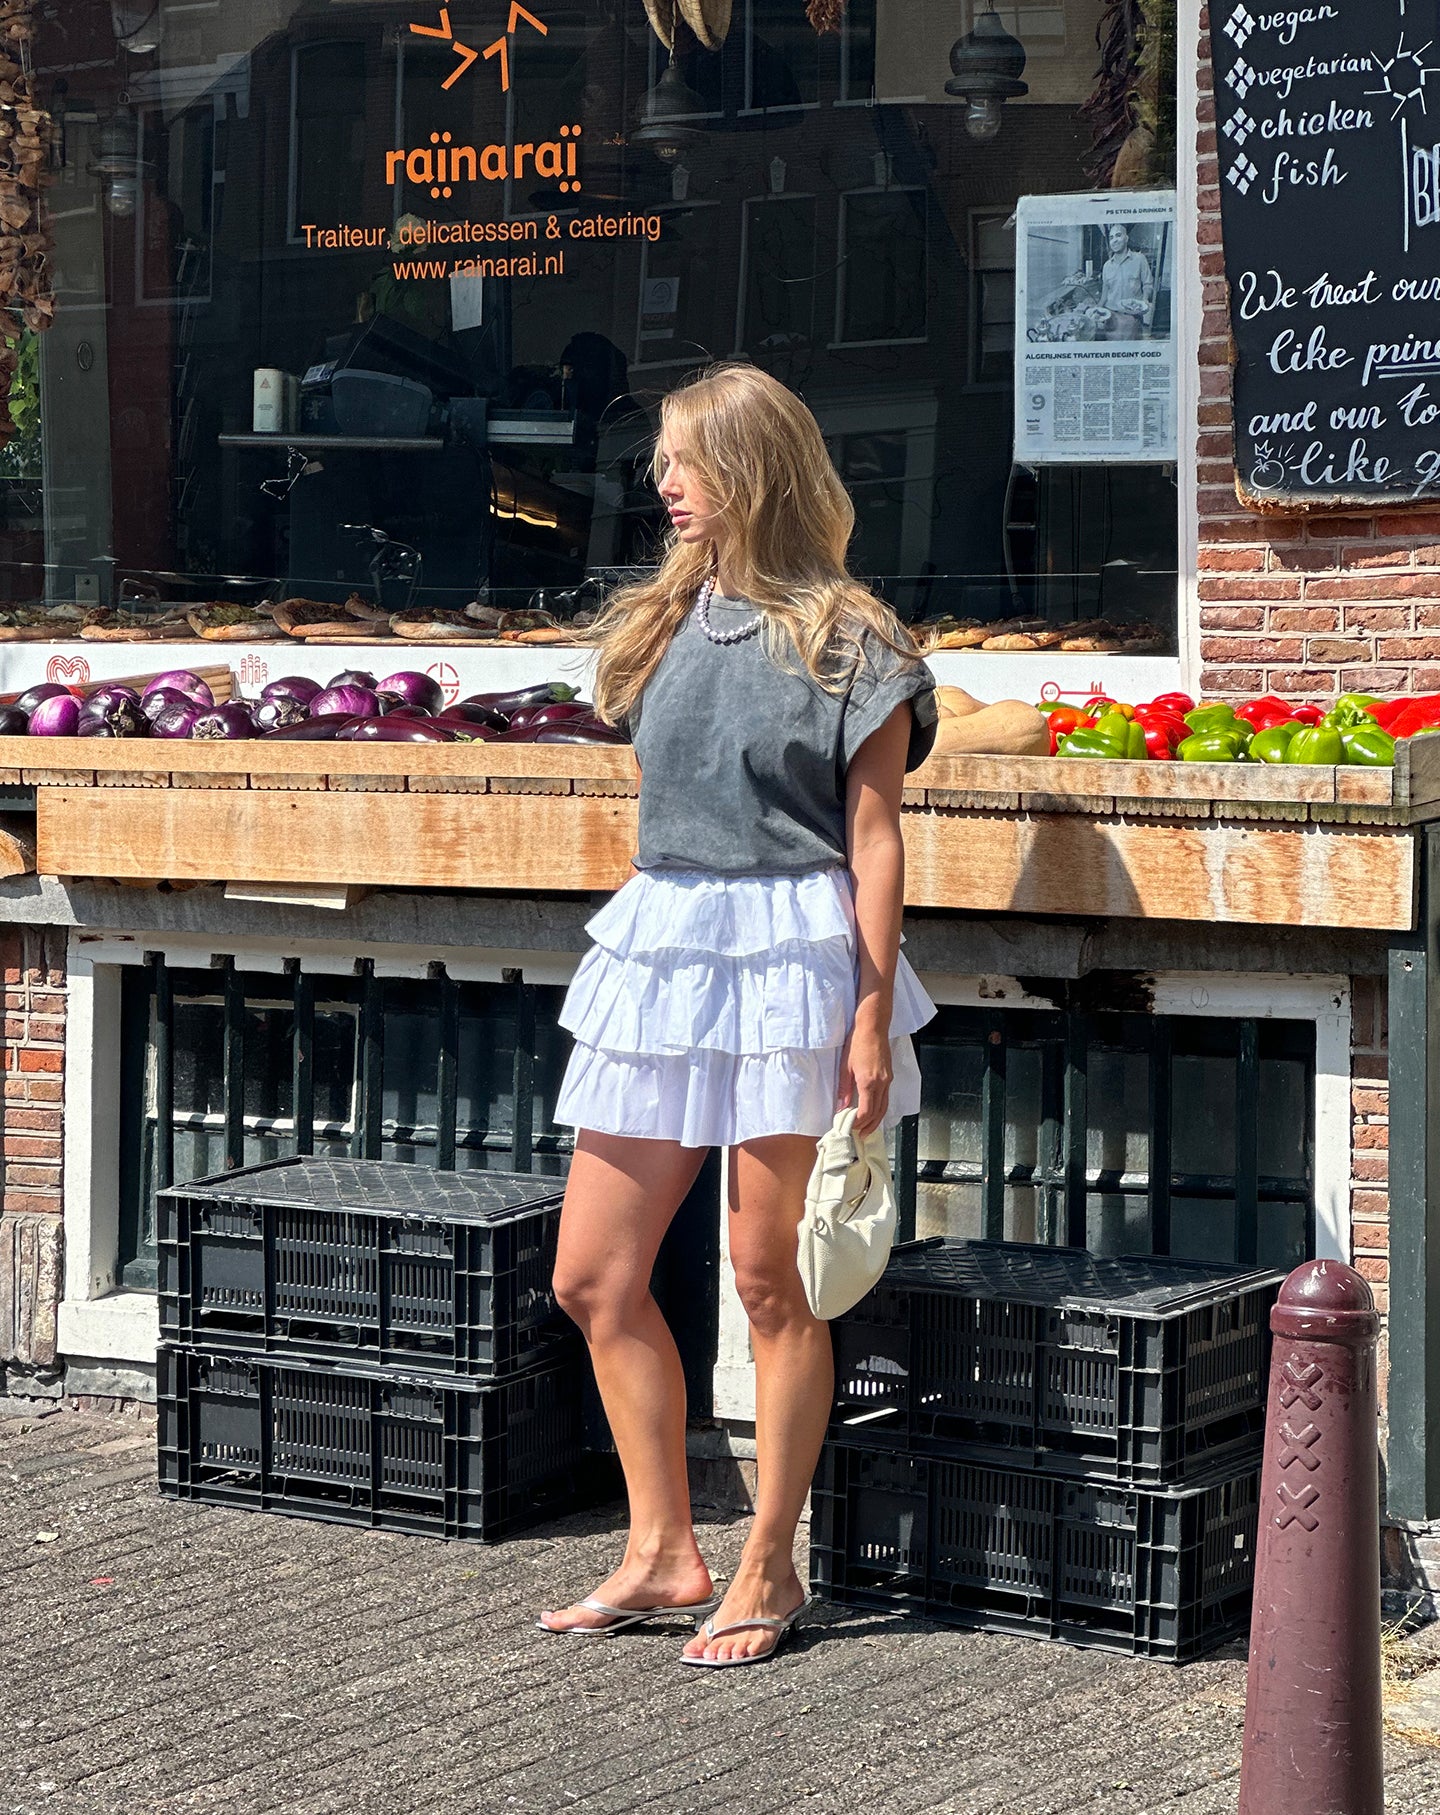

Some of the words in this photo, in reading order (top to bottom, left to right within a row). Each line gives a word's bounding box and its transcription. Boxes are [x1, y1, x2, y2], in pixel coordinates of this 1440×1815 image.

[1258, 4, 1339, 45] vegan
[1257, 52, 1373, 99] vegetarian
[1260, 100, 1375, 139] chicken
[1262, 148, 1349, 204] fish
[301, 223, 391, 249] Traiteur,
[399, 219, 538, 245] delicatessen
[545, 214, 562, 239] &
[569, 211, 661, 242] catering
[393, 250, 564, 280] www.rainarai.nl
[1239, 270, 1298, 320] We
[1302, 270, 1383, 309] treat
[1025, 352, 1072, 360] ALGERIJNSE
[1266, 325, 1354, 374] like
[1031, 394, 1046, 411] 9
[1249, 401, 1318, 436] and
[1330, 405, 1387, 429] our
[1290, 437, 1402, 485] like
